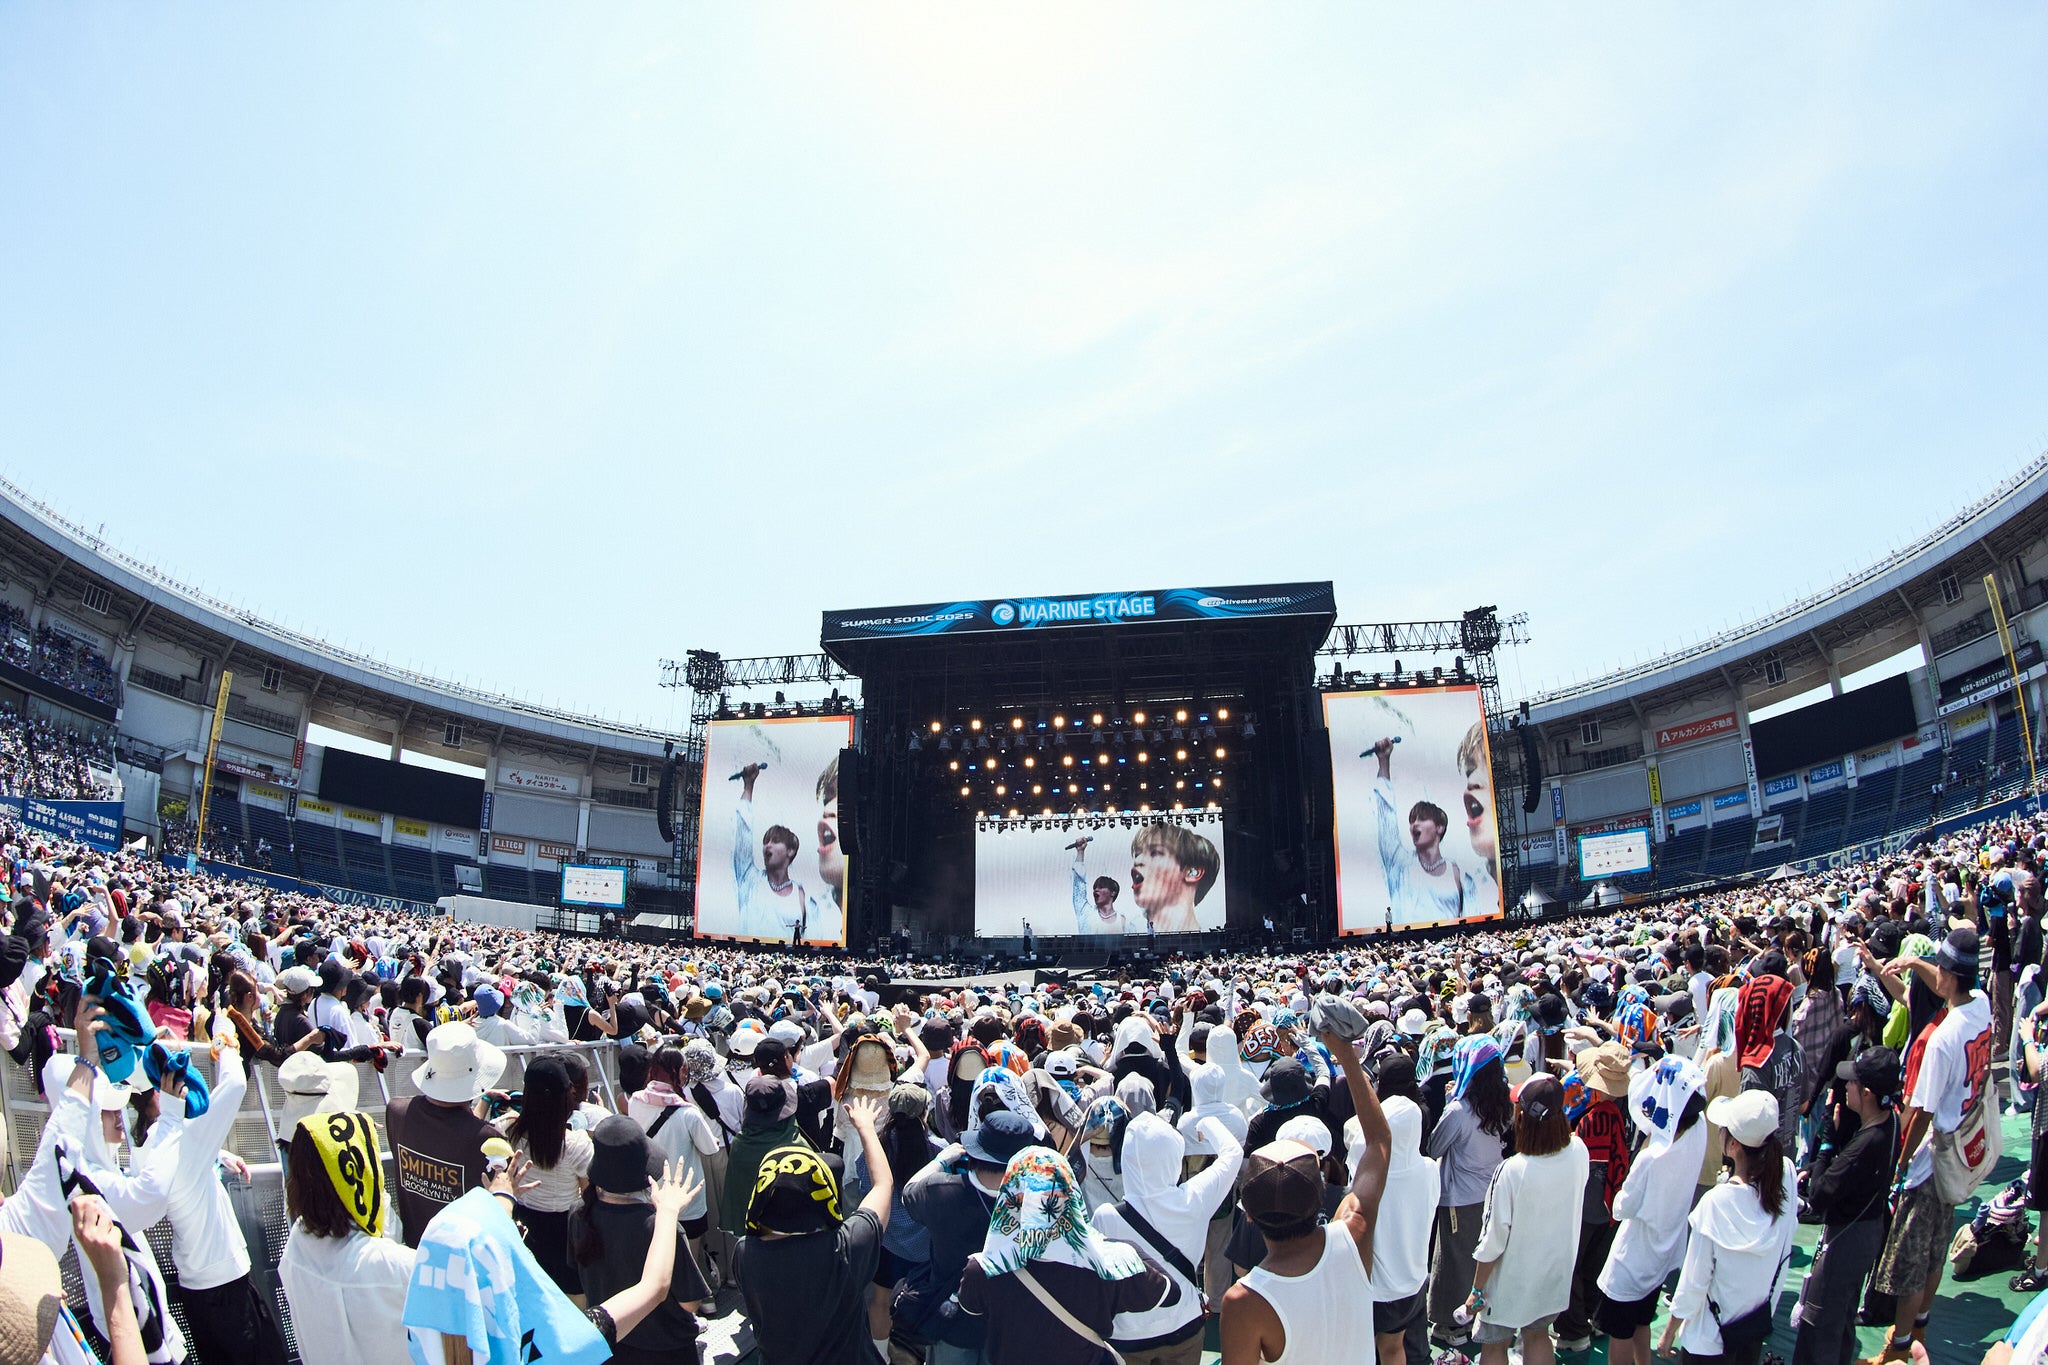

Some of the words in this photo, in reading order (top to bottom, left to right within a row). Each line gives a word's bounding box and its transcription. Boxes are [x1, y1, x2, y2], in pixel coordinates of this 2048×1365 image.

[841, 618, 892, 628] SUMMER
[894, 615, 933, 624] SONIC
[936, 612, 974, 621] 2025
[1020, 601, 1090, 621] MARINE
[1095, 597, 1154, 617] STAGE
[534, 774, 559, 782] NARITA
[400, 1148, 459, 1187] SMITH'S
[405, 1172, 430, 1187] TAILOR
[430, 1182, 453, 1195] MADE
